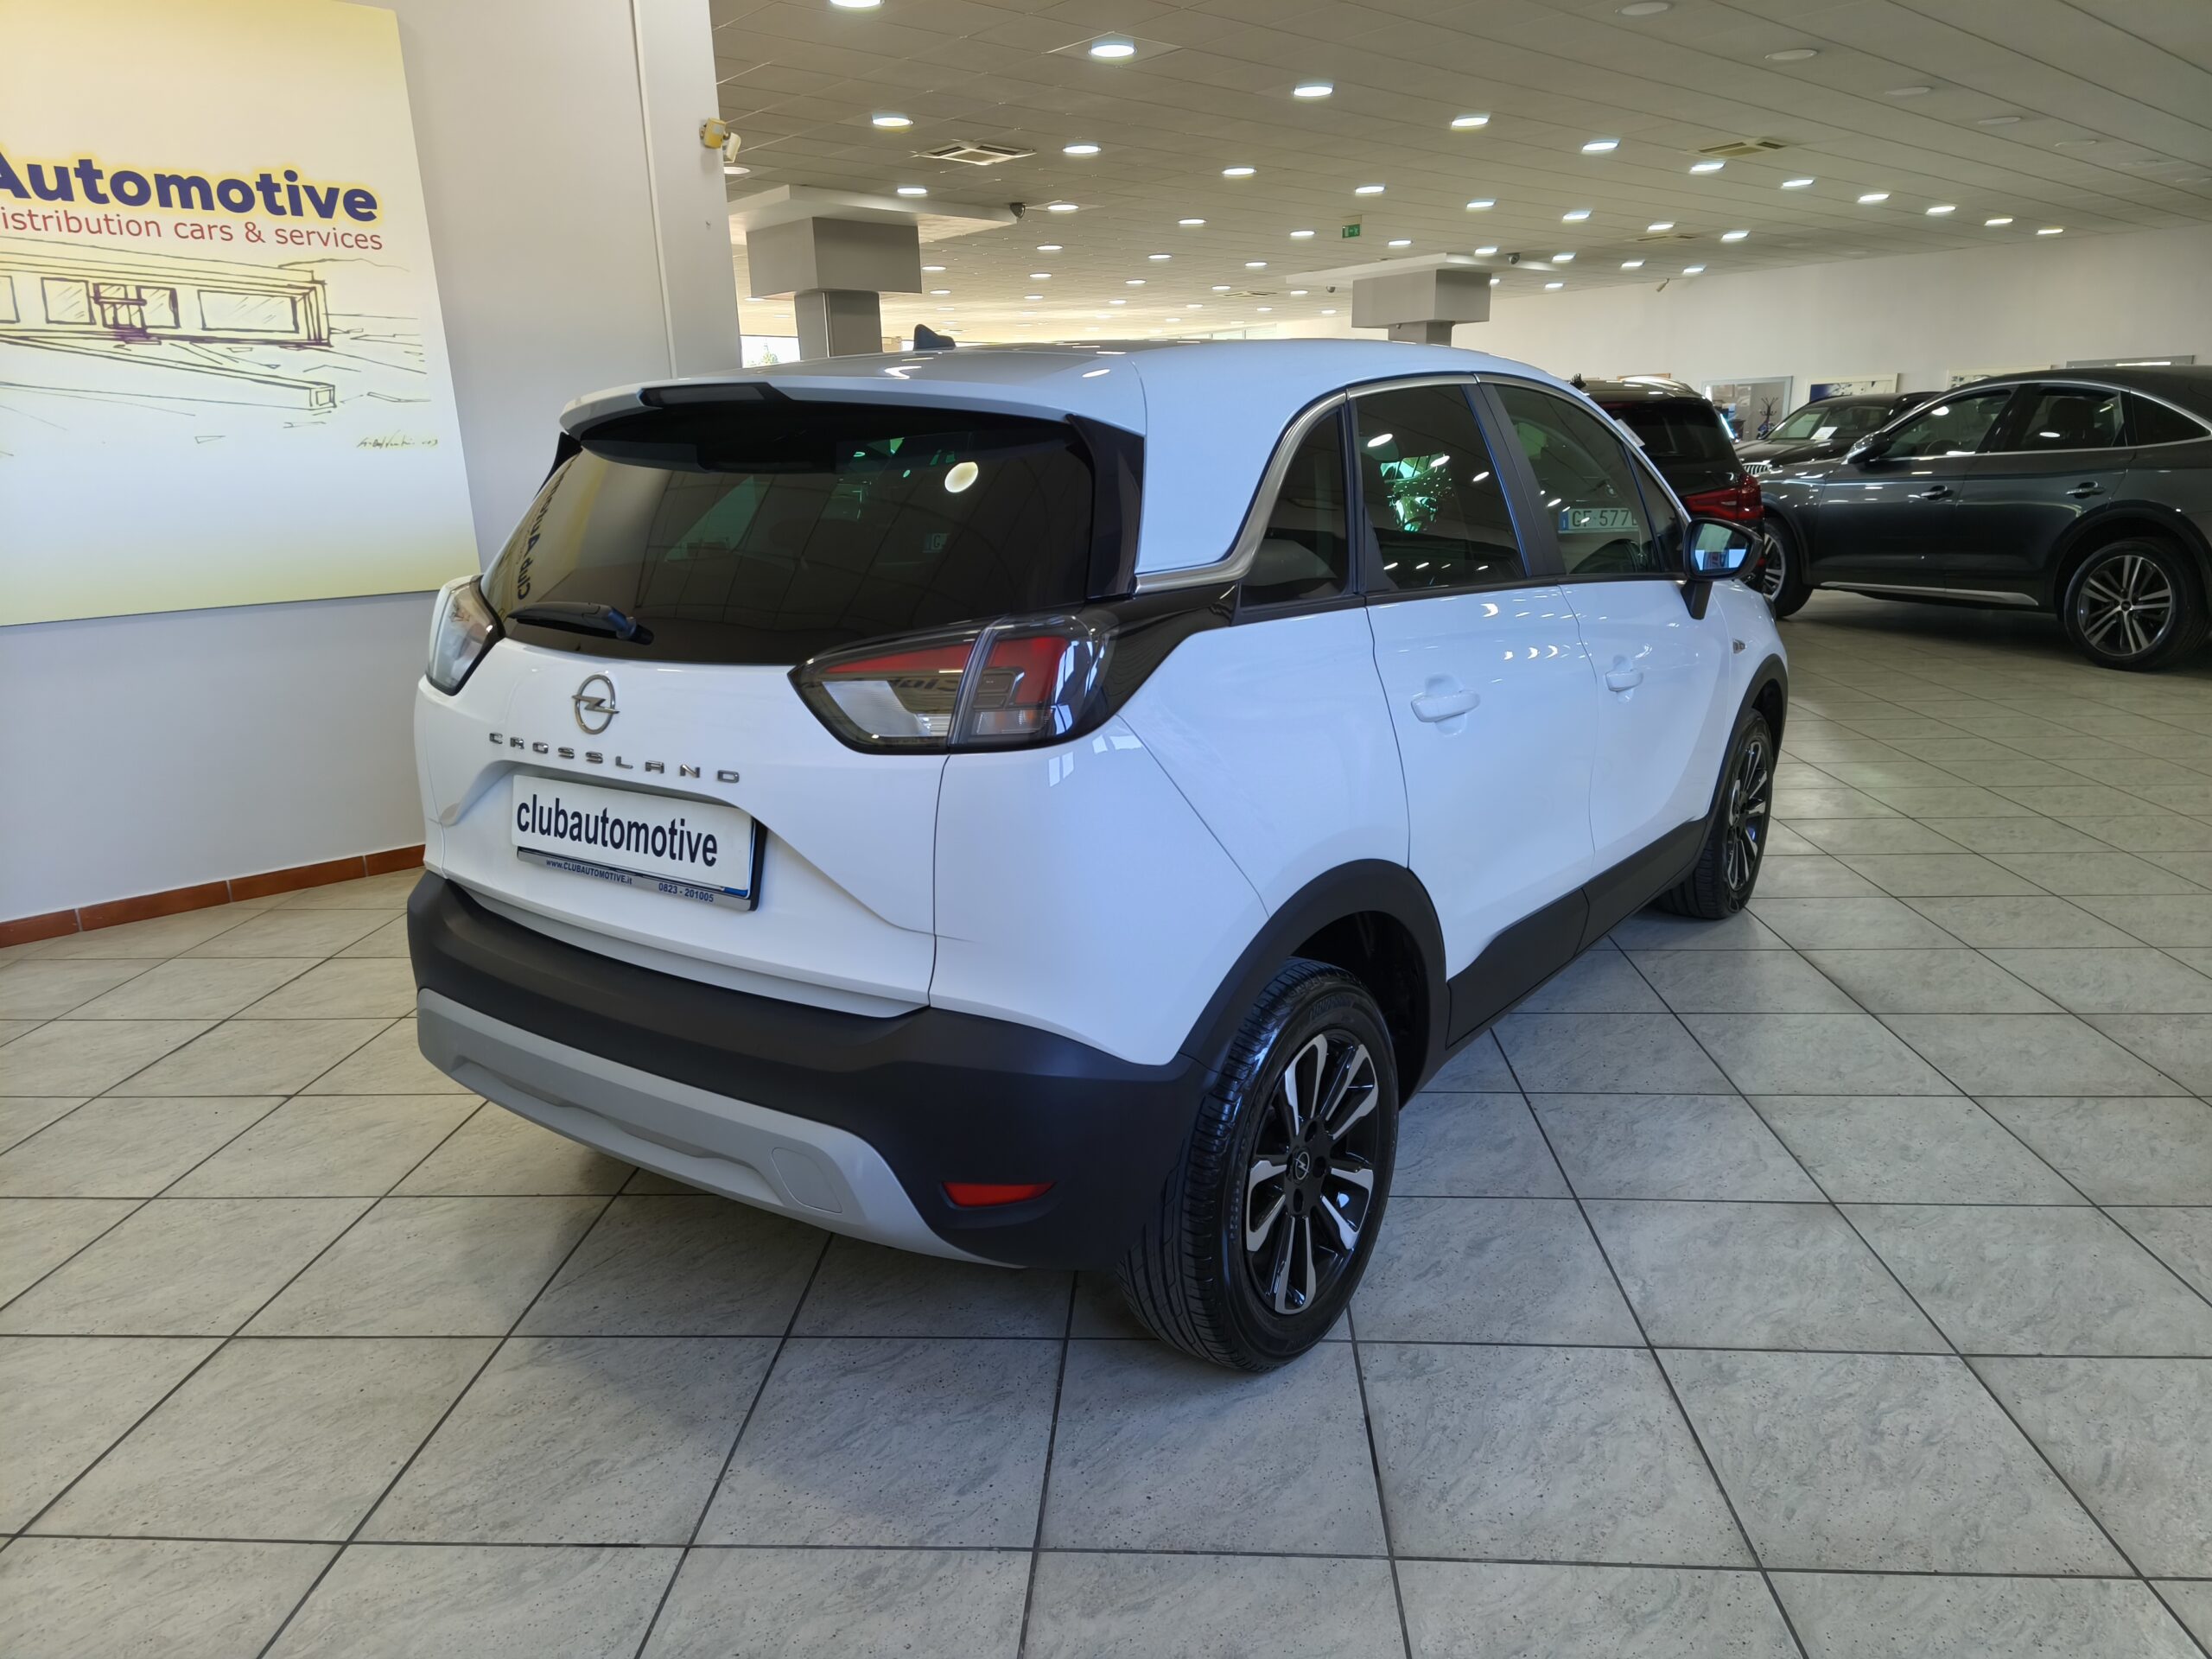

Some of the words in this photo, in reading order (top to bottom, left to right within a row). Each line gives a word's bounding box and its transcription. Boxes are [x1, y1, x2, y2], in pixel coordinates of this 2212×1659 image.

[174, 221, 233, 242] cars
[245, 221, 266, 244] &
[275, 226, 383, 251] services
[489, 732, 741, 784] CROSSLAND
[517, 794, 718, 868] clubautomotive
[546, 859, 632, 886] www.CLUBAUTOMOTIVE.it
[658, 882, 678, 894] 0823
[684, 887, 714, 902] 201005
